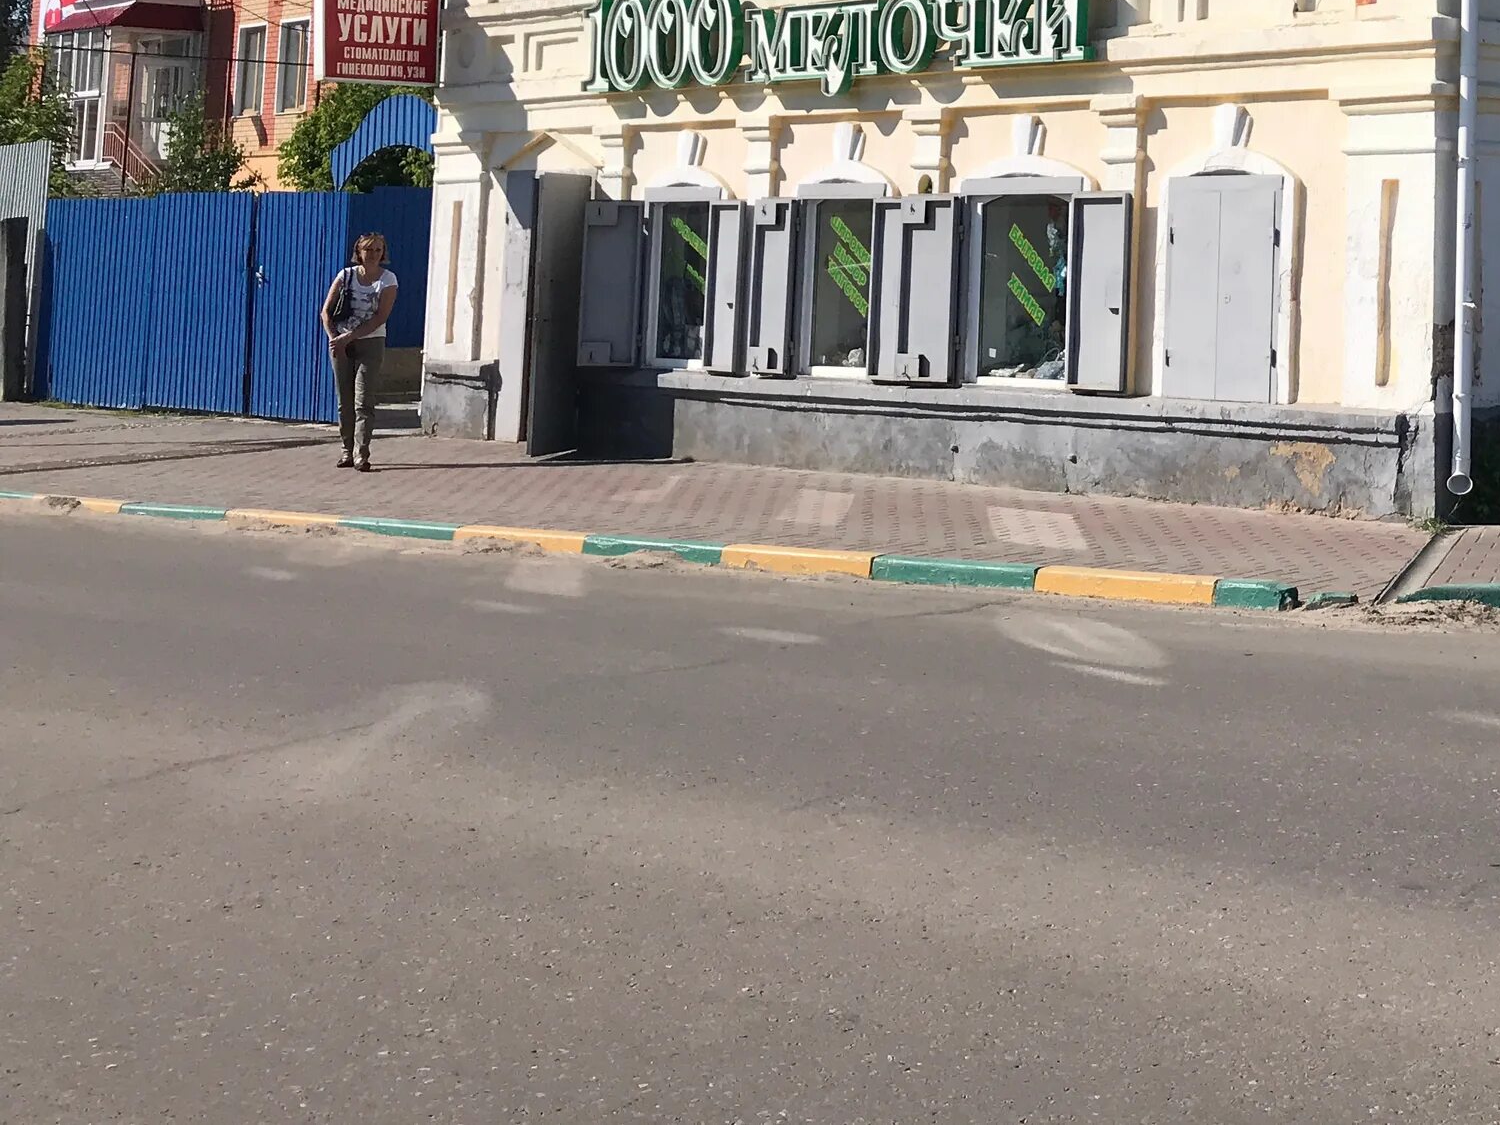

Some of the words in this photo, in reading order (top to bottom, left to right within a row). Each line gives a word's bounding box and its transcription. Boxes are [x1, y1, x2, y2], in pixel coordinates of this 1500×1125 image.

[337, 13, 428, 46] УСЛУГИ
[344, 47, 419, 62] СТОМАТОЛОГИЯ
[1008, 223, 1056, 292] БЫТОВАЯ
[1007, 272, 1046, 326] ХИМИЯ
